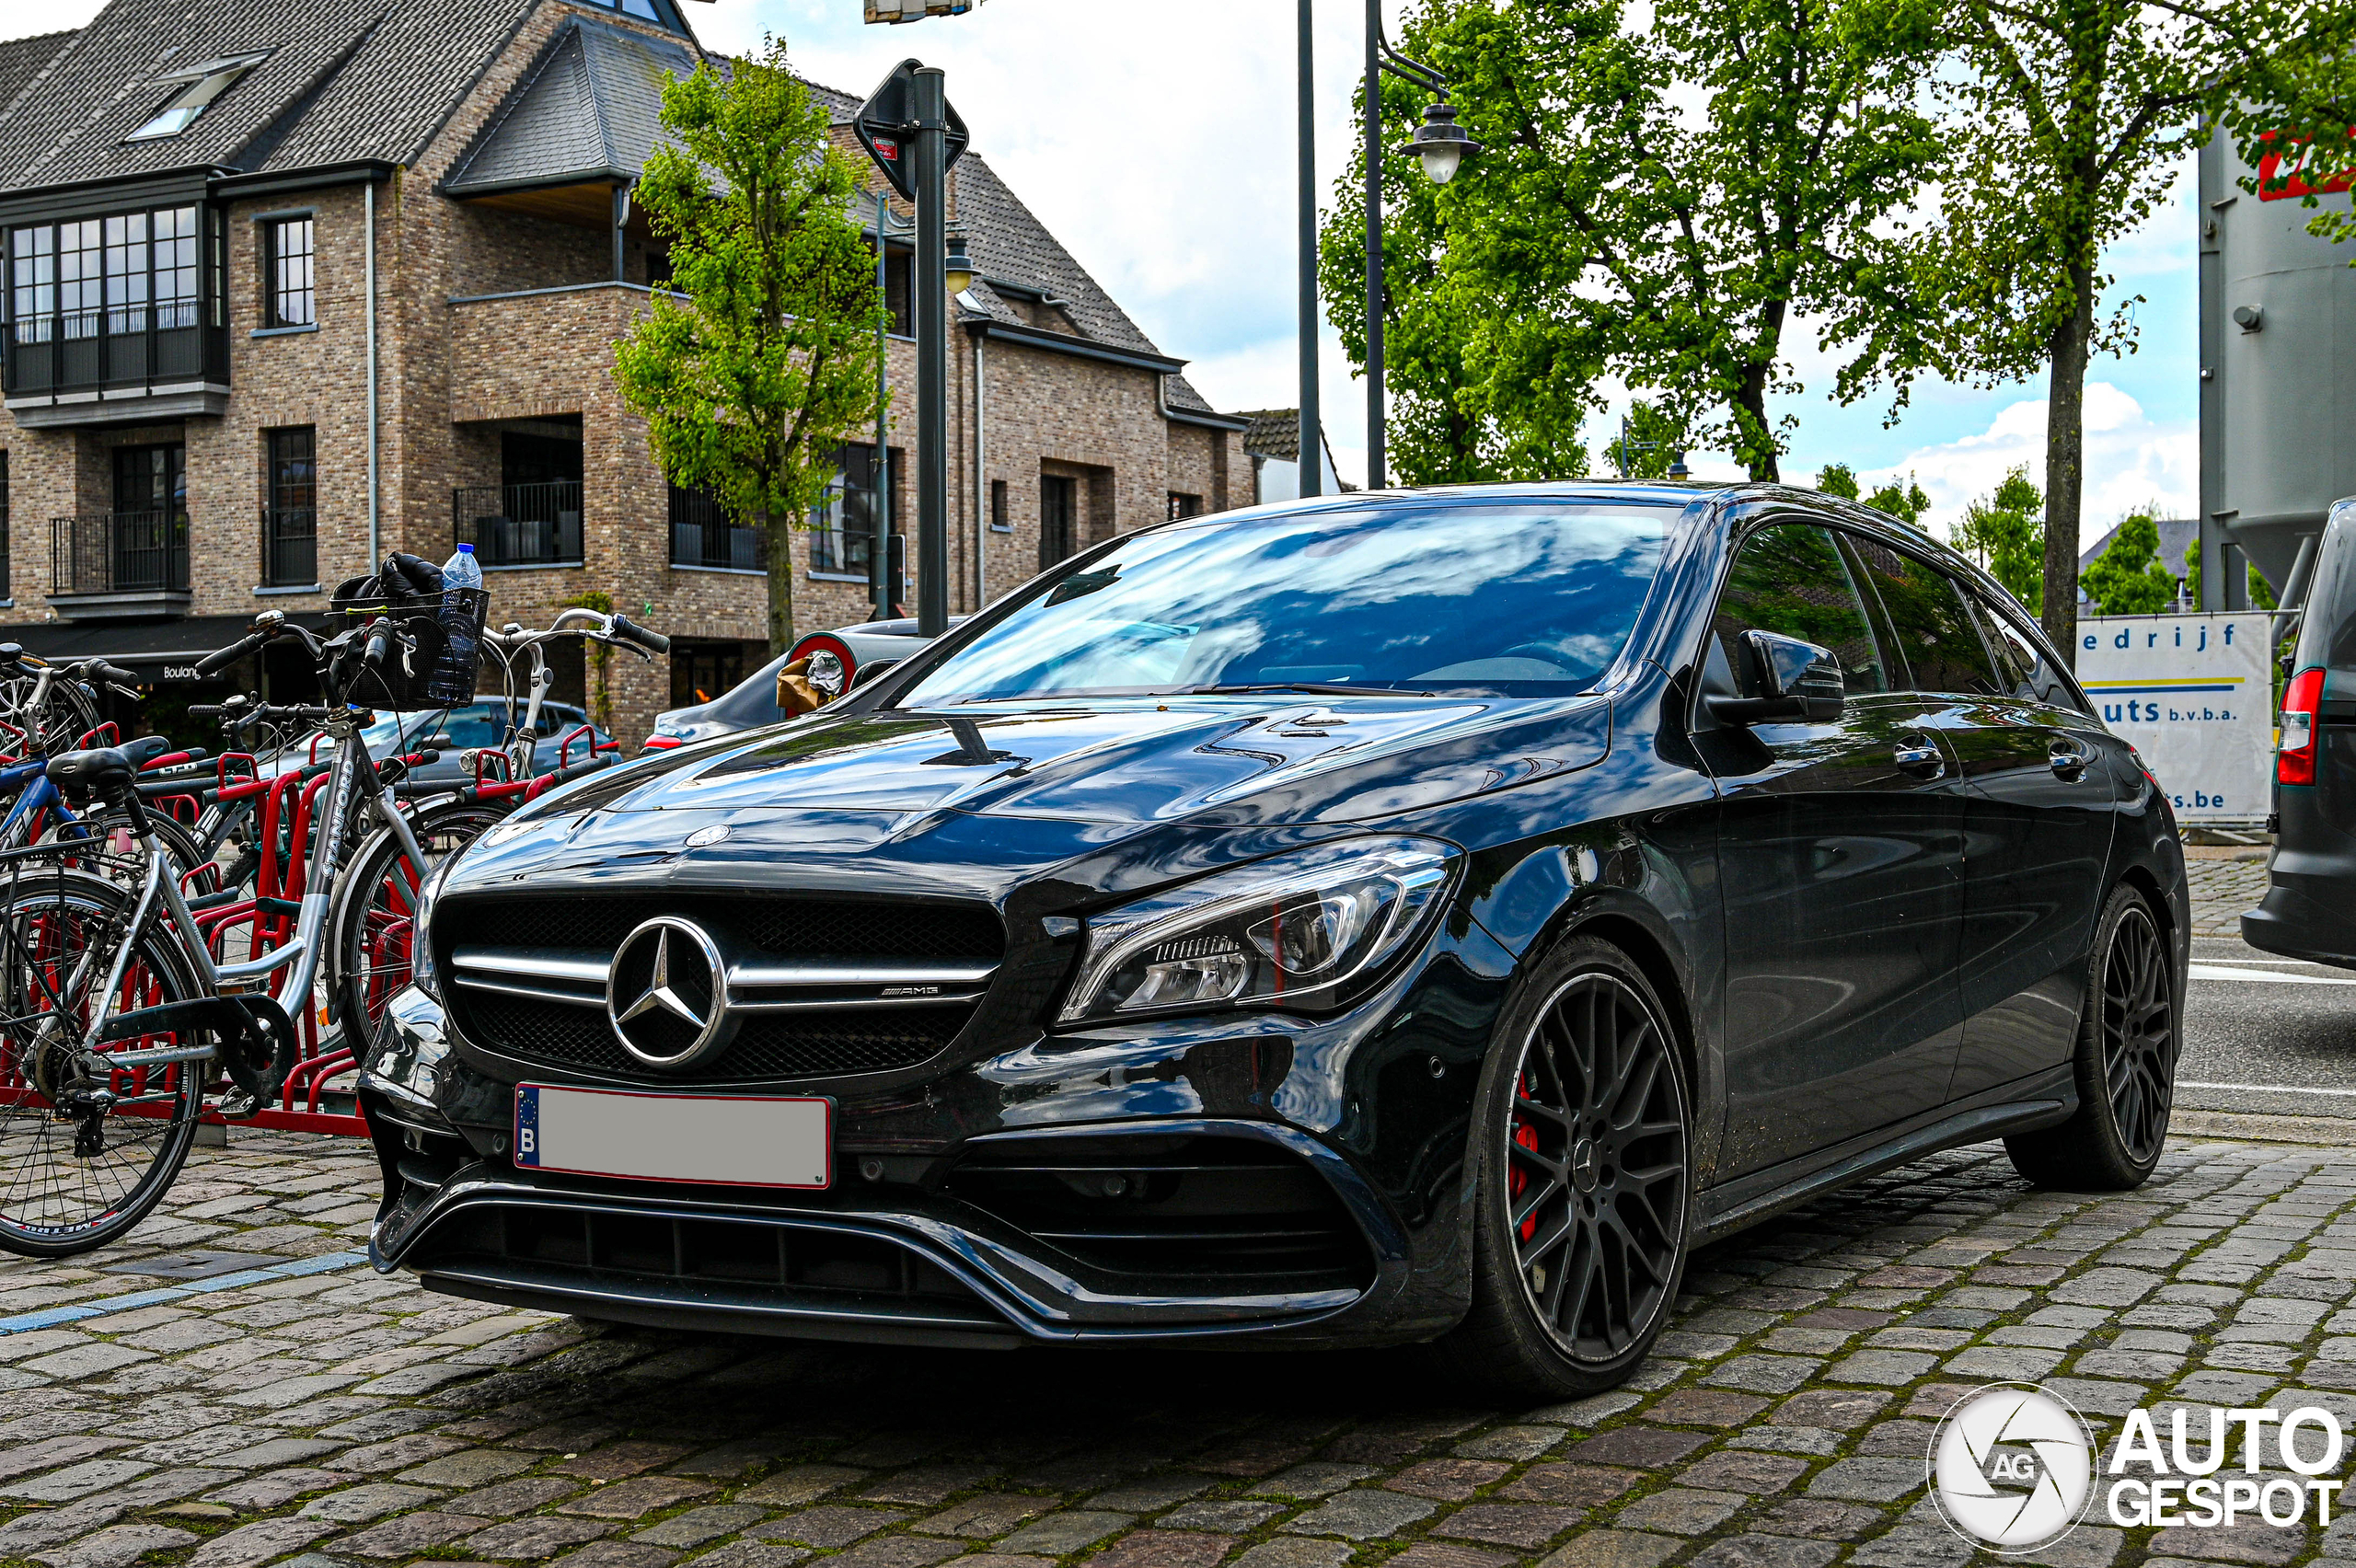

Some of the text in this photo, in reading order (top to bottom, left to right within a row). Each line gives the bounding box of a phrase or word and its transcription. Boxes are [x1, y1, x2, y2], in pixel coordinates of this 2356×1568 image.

[2168, 708, 2237, 721] b.v.b.a.
[321, 758, 355, 880] STANFORD
[175, 888, 202, 945] STANFORD
[899, 986, 939, 996] AMG
[521, 1128, 535, 1153] B
